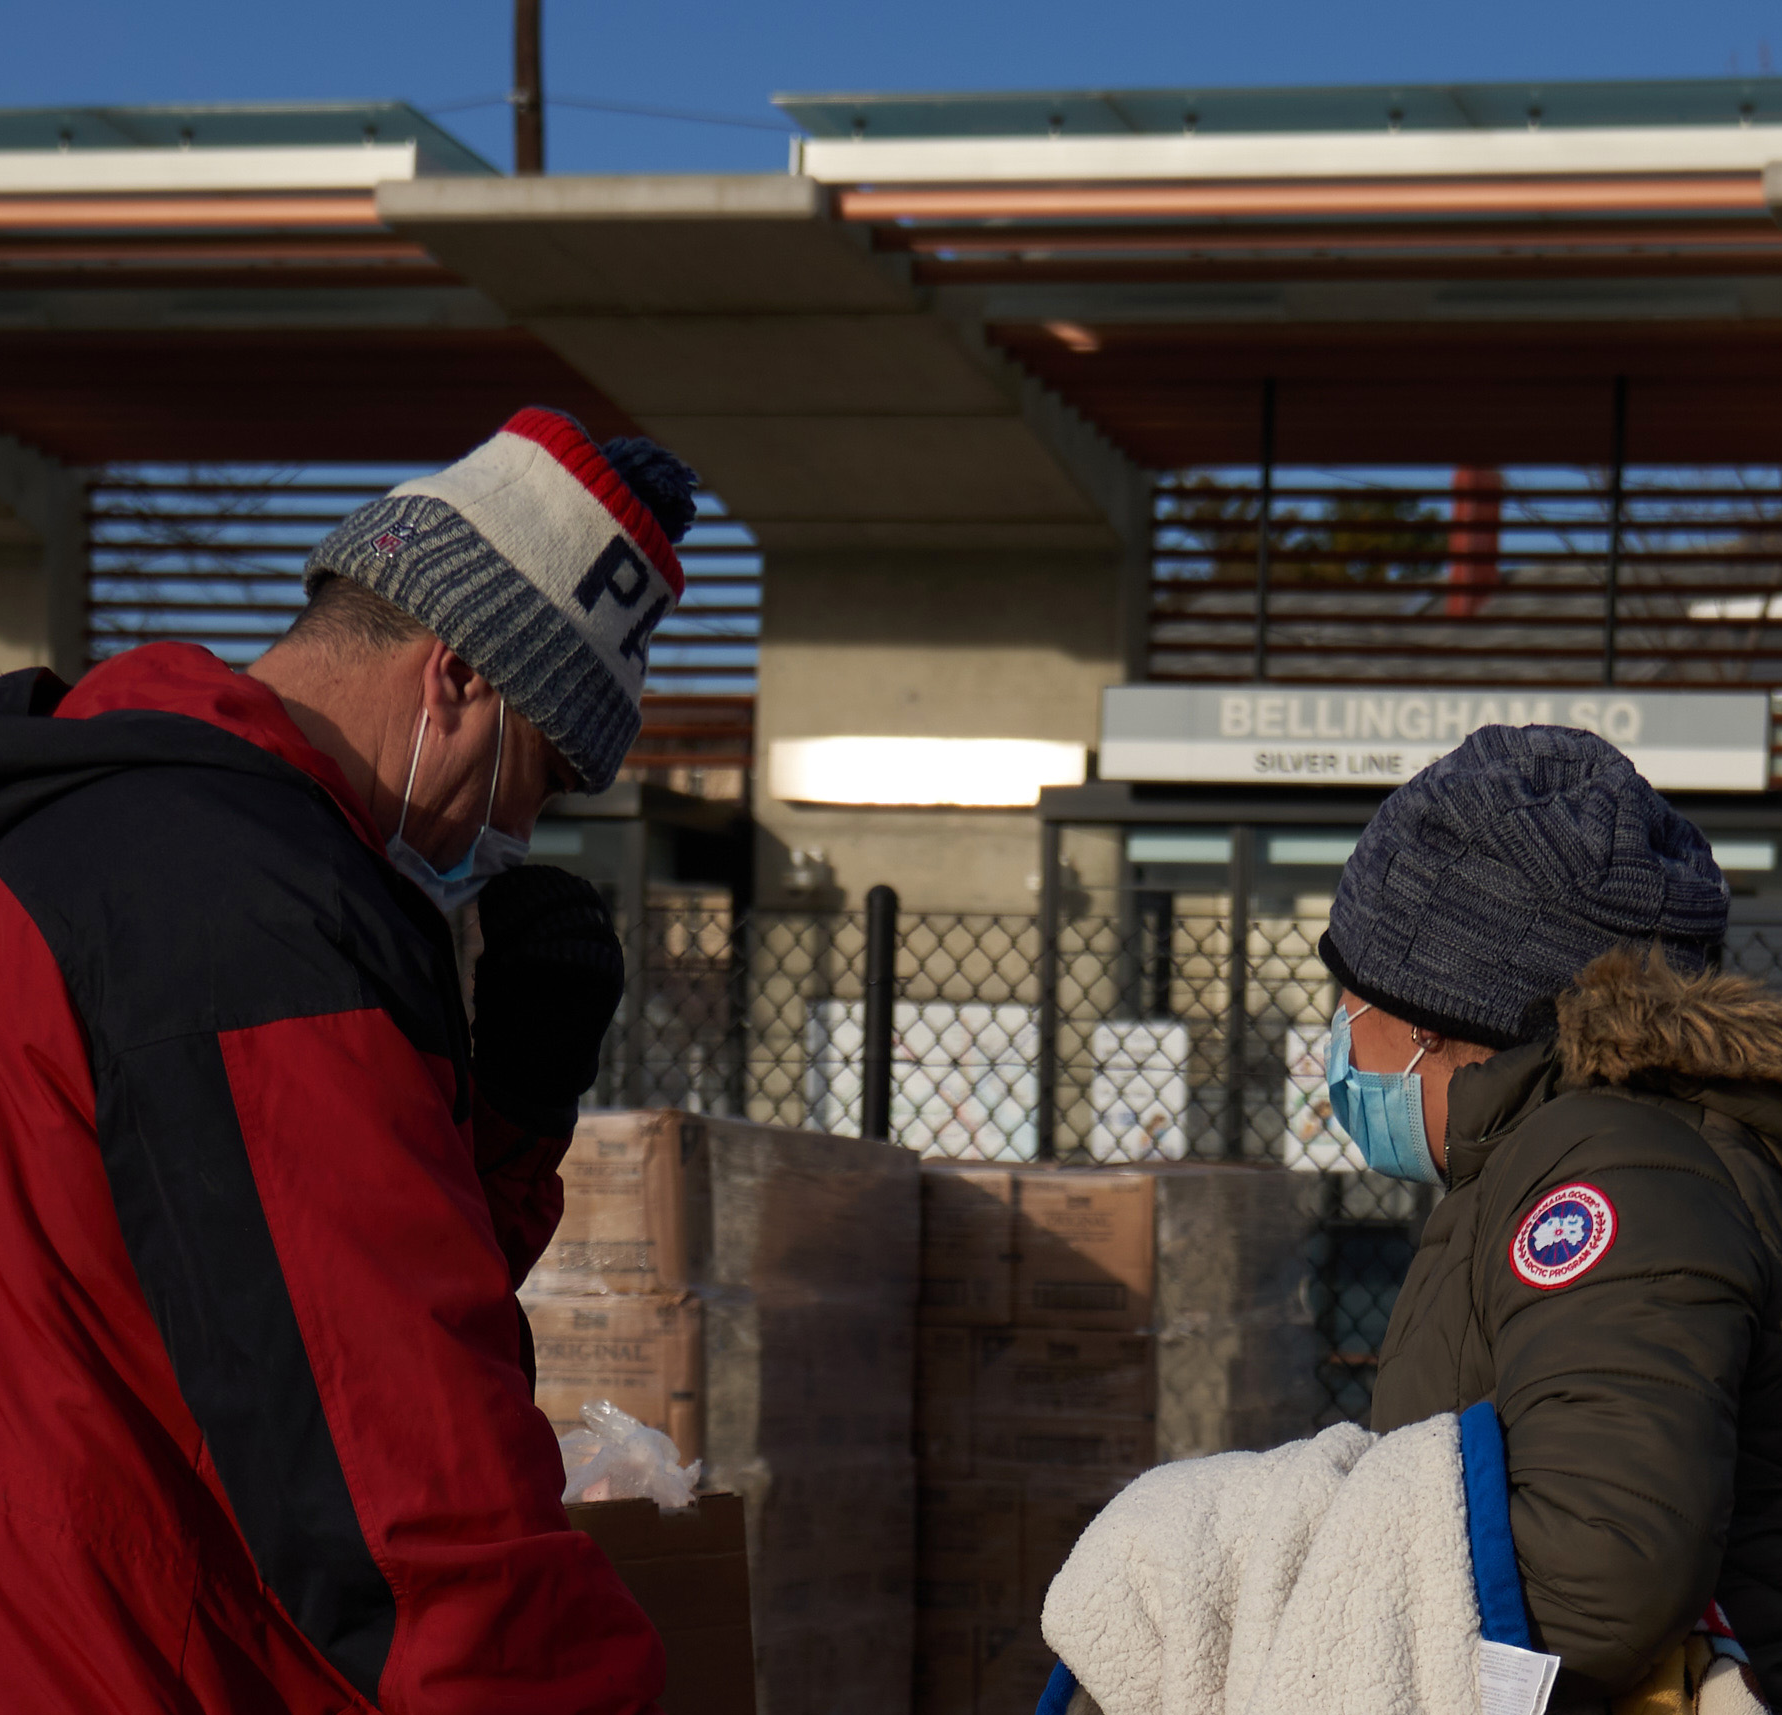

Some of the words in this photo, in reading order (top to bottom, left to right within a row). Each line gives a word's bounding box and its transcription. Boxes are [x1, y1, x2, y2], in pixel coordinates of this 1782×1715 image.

[1569, 699, 1643, 743] SQ
[1255, 753, 1338, 774] SILVER
[1347, 754, 1402, 775] LINE
[1533, 1193, 1566, 1220] CANADA
[1524, 1258, 1547, 1277] ARCTIC
[1549, 1250, 1591, 1278] PROGRAM
